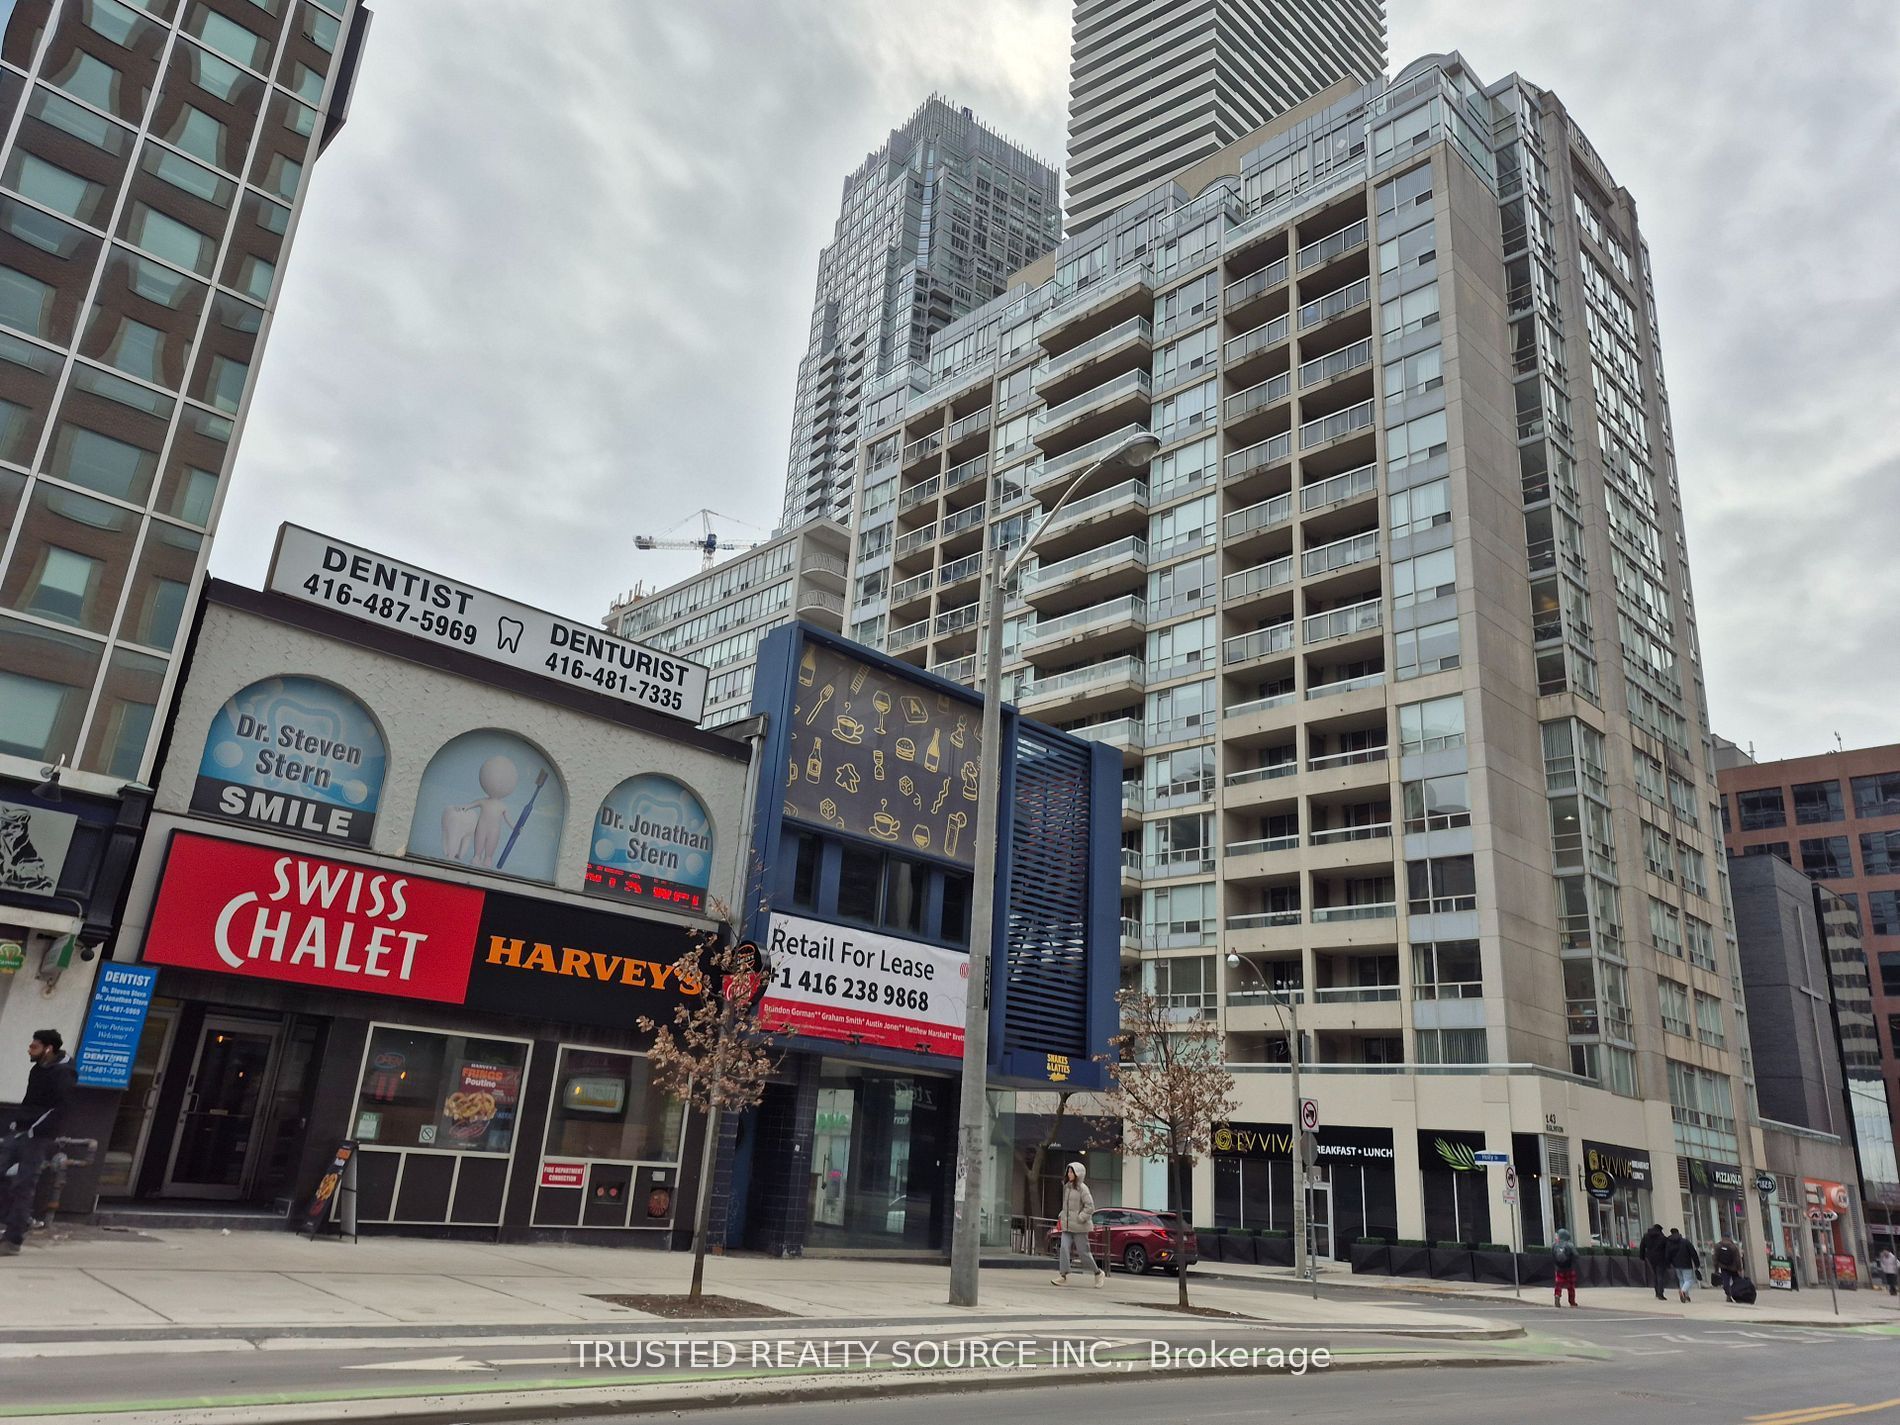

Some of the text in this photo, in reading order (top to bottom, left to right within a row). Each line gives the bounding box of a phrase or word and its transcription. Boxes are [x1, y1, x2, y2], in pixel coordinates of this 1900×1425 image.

[322, 545, 474, 614] DENTIST
[303, 573, 478, 645] 416-487-5969
[549, 622, 689, 686] DENTURIST
[544, 652, 683, 711] 416-481-7335
[236, 713, 363, 766] Dr. Steven
[255, 748, 332, 789] Stern
[219, 785, 353, 838] SMILE
[600, 806, 711, 851] Dr. Jonathan
[627, 837, 680, 870] Stern
[268, 856, 409, 922] SWISS
[213, 891, 429, 981] CHALET
[771, 928, 935, 981] Retail For Lease
[104, 970, 151, 987] DENTIST
[485, 935, 703, 995] HARVEY'S
[770, 966, 929, 1012] +1 416 238 9868
[109, 1023, 135, 1033] Patients
[763, 1003, 791, 1015] Brandon
[821, 1012, 845, 1022] Graham
[865, 1019, 883, 1029] Austin
[905, 1025, 927, 1036] Matthew
[465, 1077, 497, 1089] Poutine
[543, 1166, 584, 1175] FIRE DEPARTMENT
[1317, 1144, 1393, 1158] REAKFAST LUNCH
